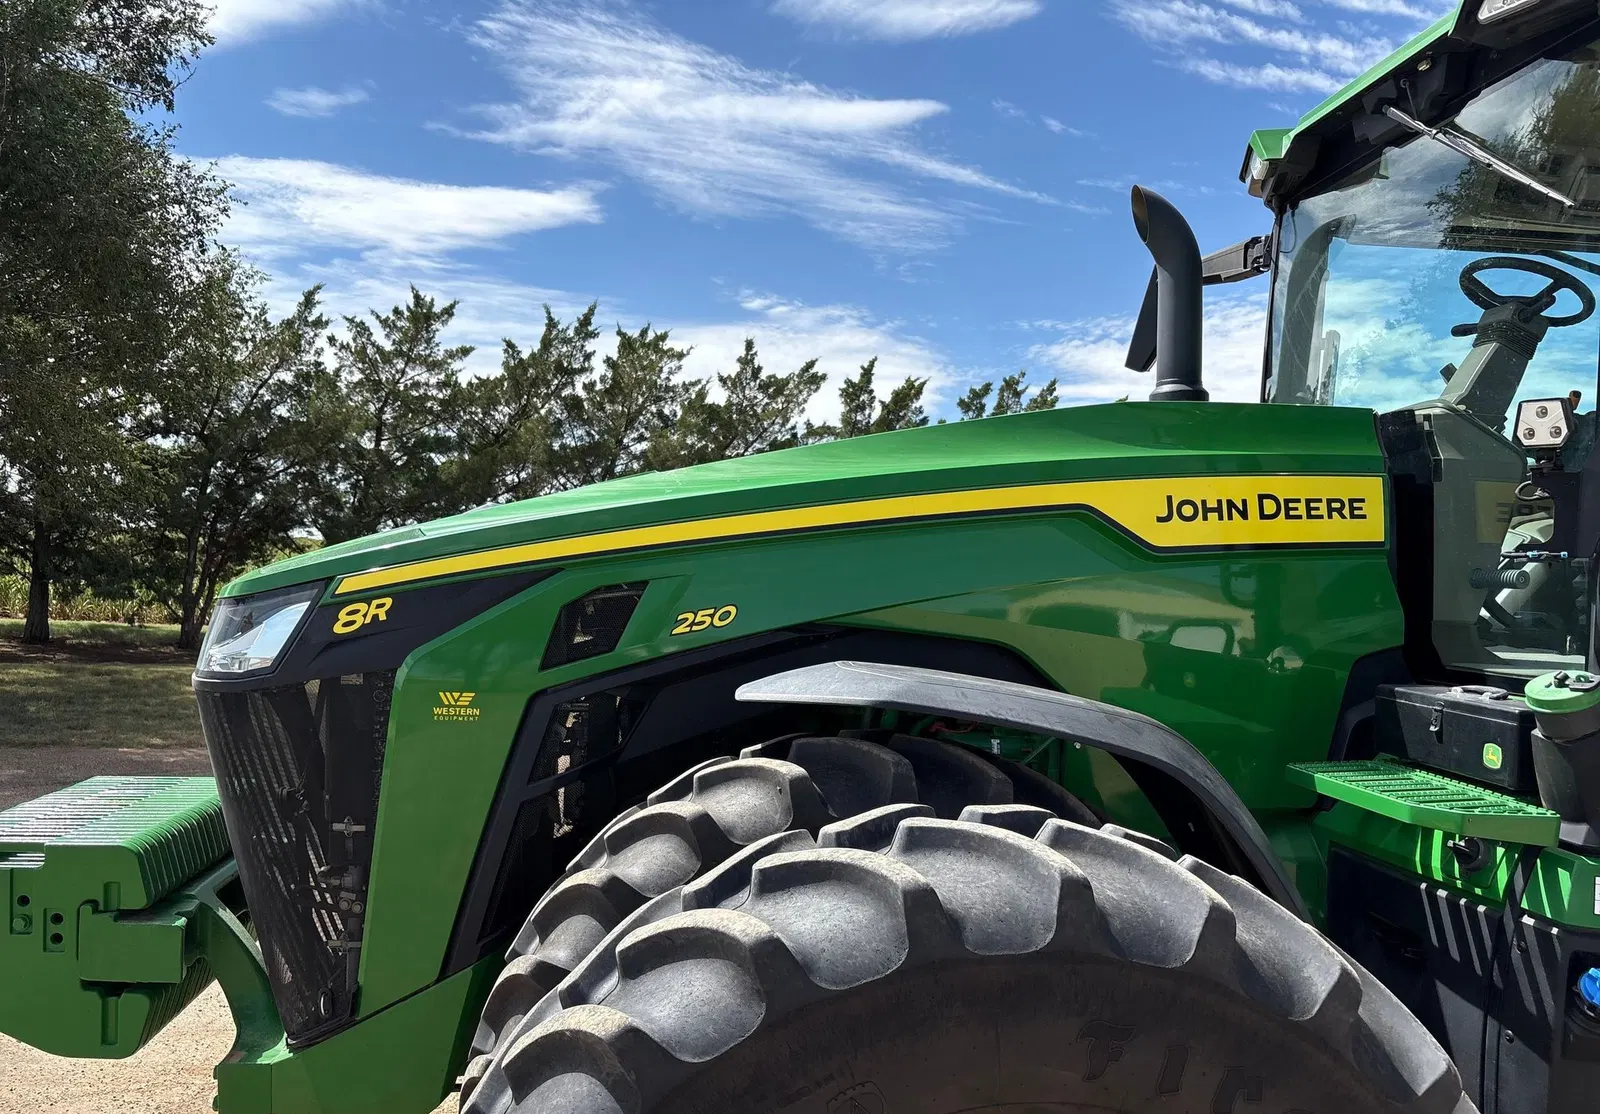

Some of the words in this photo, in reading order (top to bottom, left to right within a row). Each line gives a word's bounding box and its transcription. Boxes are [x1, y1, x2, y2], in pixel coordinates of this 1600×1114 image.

[1155, 494, 1249, 523] JOHN
[1257, 493, 1367, 521] DEERE
[332, 596, 393, 635] 8R
[669, 603, 739, 637] 250
[432, 706, 480, 715] WESTERN
